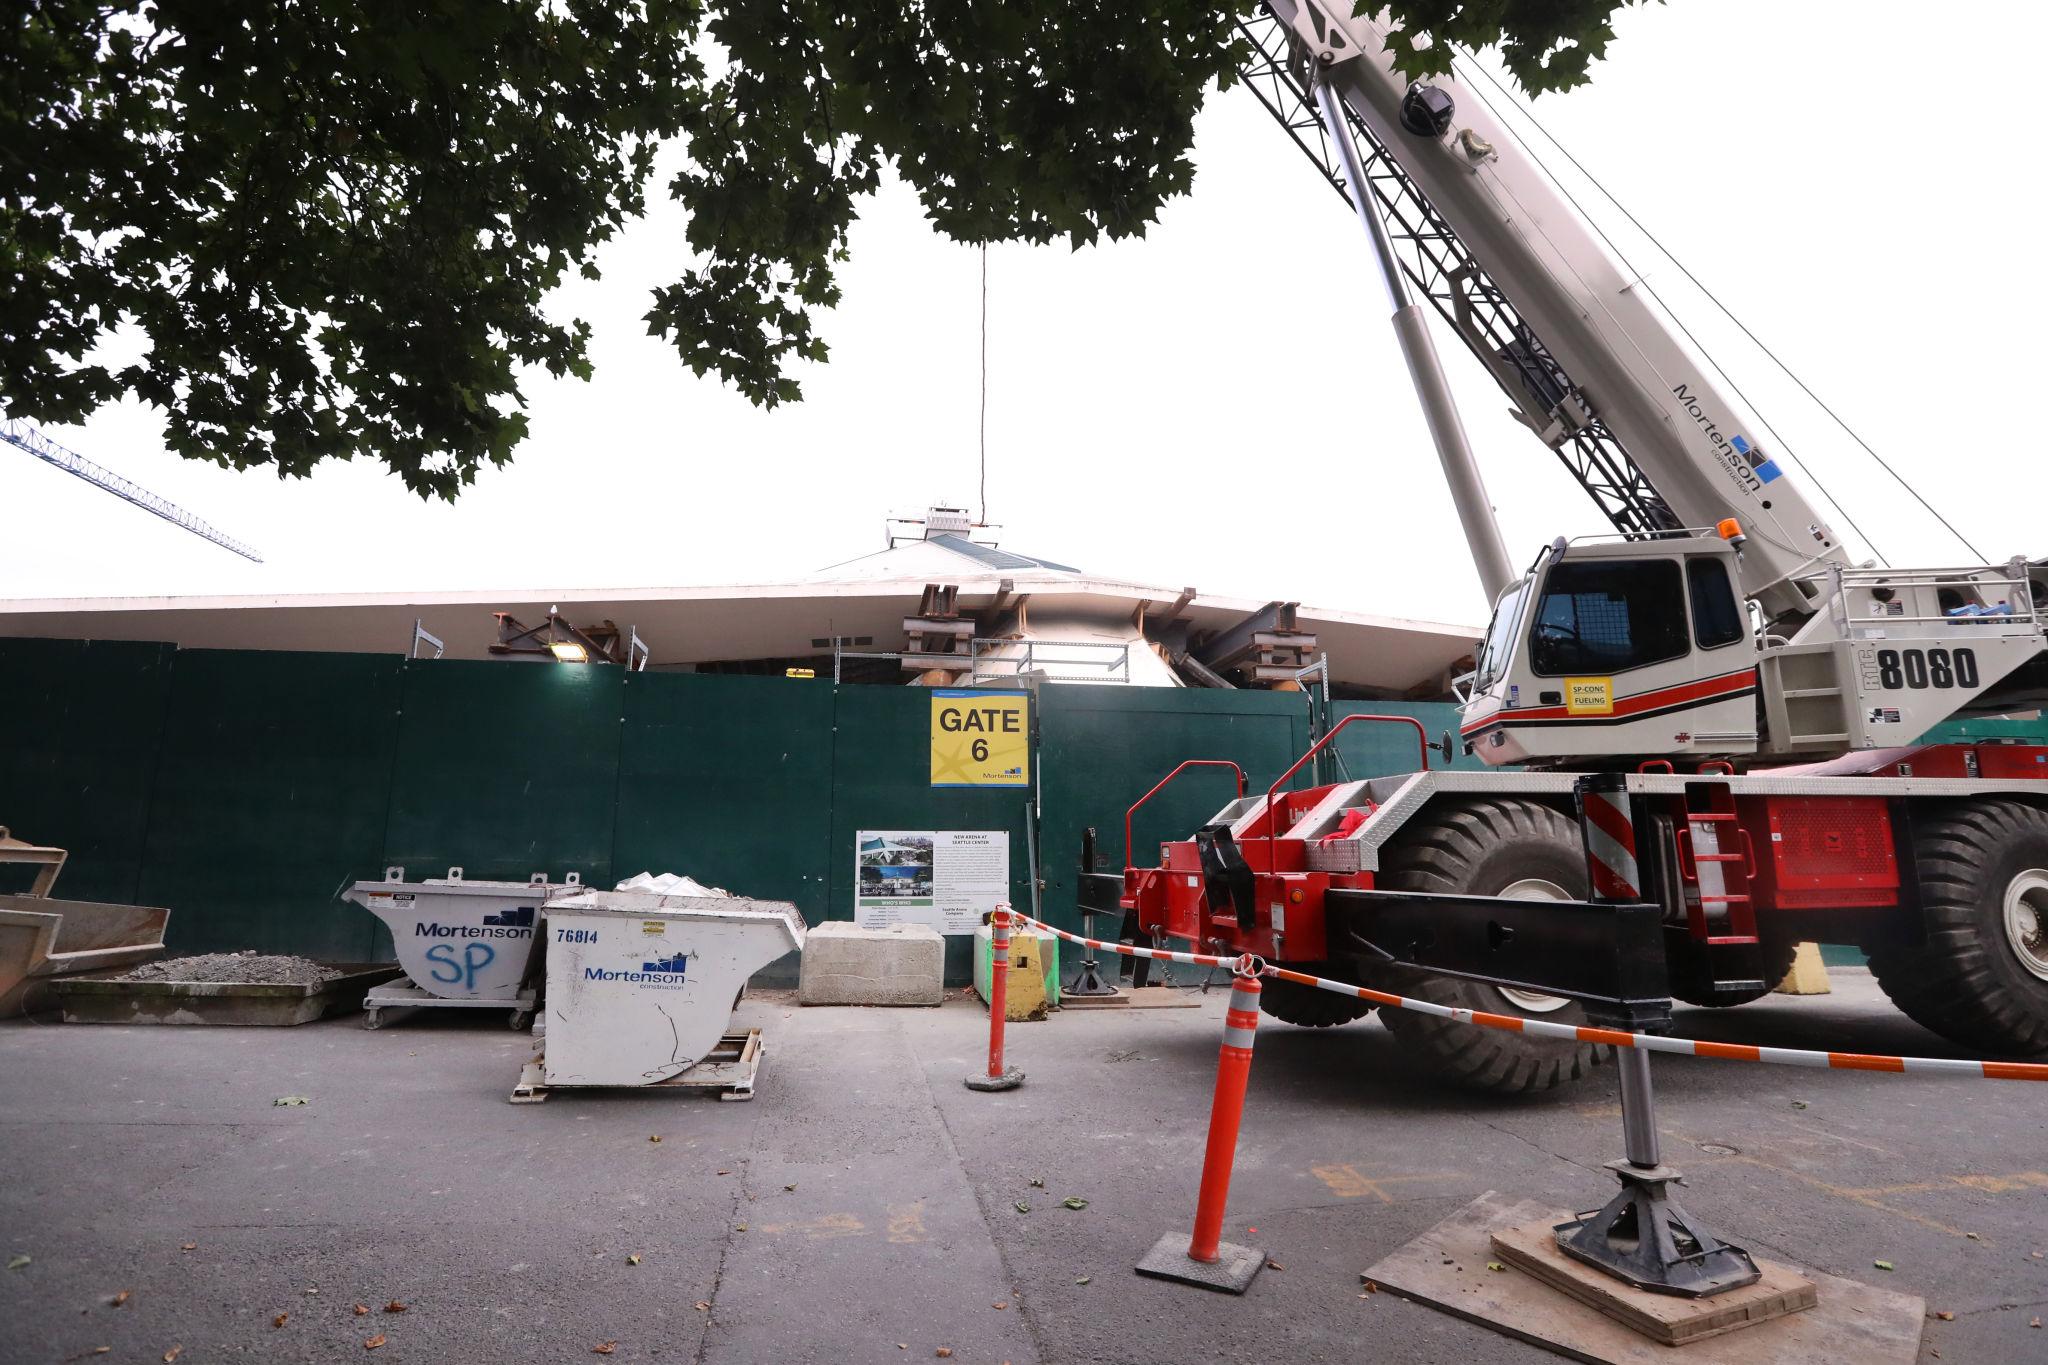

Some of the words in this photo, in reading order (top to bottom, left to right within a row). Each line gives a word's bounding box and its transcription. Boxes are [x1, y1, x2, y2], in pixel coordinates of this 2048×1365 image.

[1673, 384, 1761, 492] Mortenson
[1711, 449, 1750, 496] construction
[1877, 647, 1980, 690] 8080
[1573, 686, 1605, 694] SP-CONC
[1574, 697, 1606, 705] FUELING
[939, 708, 1020, 733] GATE
[971, 738, 989, 762] 6
[415, 922, 532, 939] Mortenson
[557, 929, 598, 944] 76814
[425, 942, 495, 990] SP
[584, 967, 685, 984] Mortenson
[640, 983, 684, 991] construction
